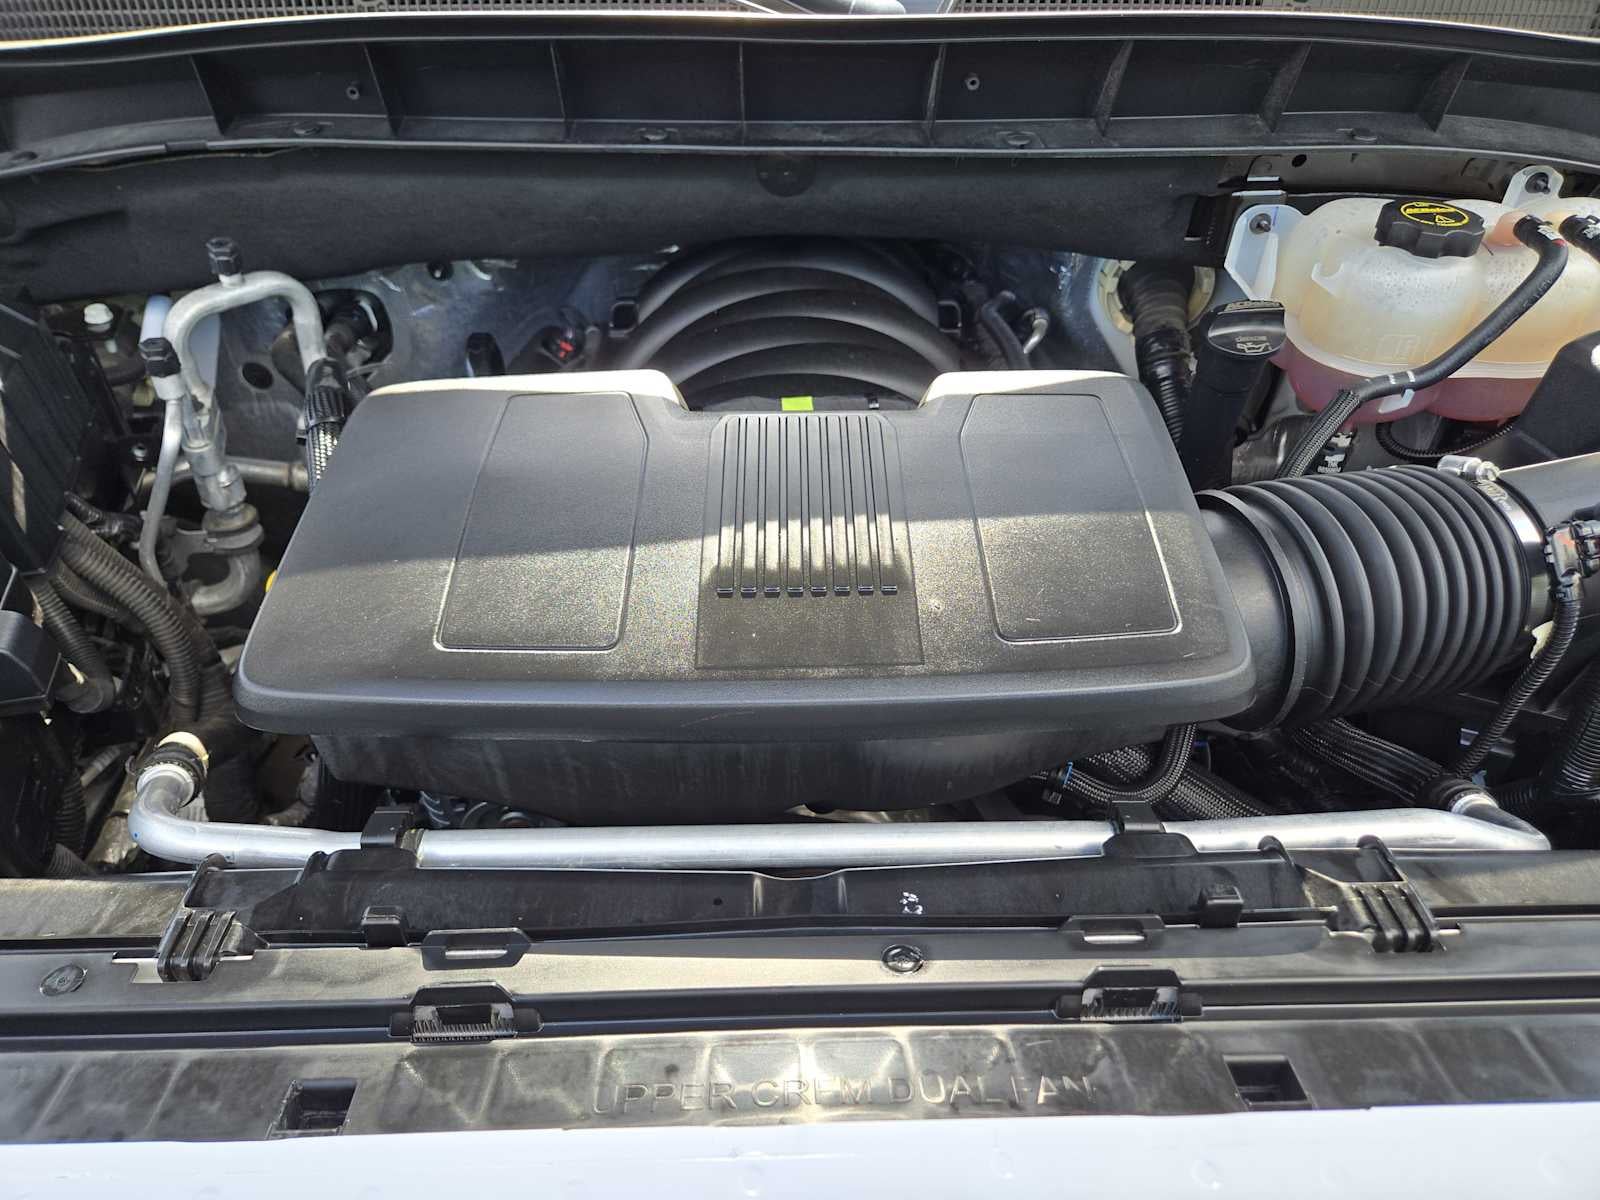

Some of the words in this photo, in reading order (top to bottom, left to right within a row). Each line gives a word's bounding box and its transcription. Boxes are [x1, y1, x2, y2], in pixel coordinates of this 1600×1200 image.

[593, 1080, 738, 1114] UPPER
[886, 1074, 1004, 1105] DUAL
[1009, 1074, 1096, 1105] FAN
